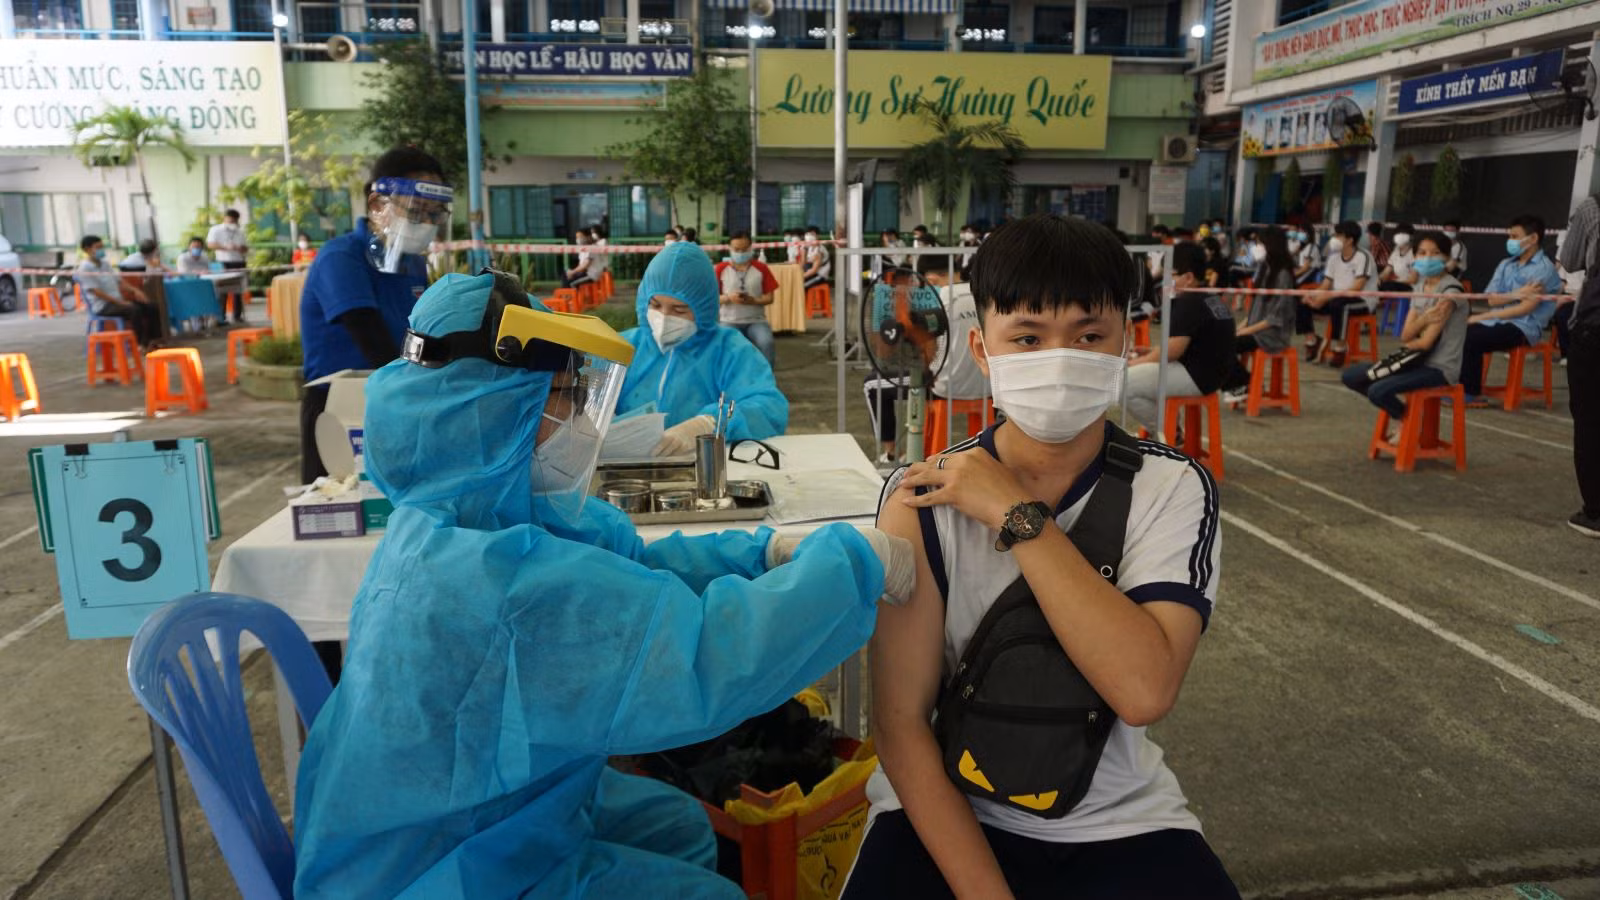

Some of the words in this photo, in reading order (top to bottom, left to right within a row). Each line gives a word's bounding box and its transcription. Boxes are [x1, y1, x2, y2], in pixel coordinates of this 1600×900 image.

[1455, 10, 1491, 28] TRÍCH
[489, 51, 526, 72] HỌC
[530, 45, 554, 69] LỄ
[564, 47, 603, 73] HẬU
[609, 51, 646, 73] HỌC
[651, 48, 689, 69] VĂN
[140, 60, 205, 91] SÁNG
[213, 66, 261, 96] TẠO
[1416, 82, 1442, 104] KÍNH
[1478, 67, 1506, 93] MẾN
[1509, 66, 1538, 89] BẠN
[190, 99, 256, 135] ĐỘNG
[932, 75, 1015, 125] Hưng
[1026, 76, 1095, 126] Quốc
[98, 498, 162, 582] 3
